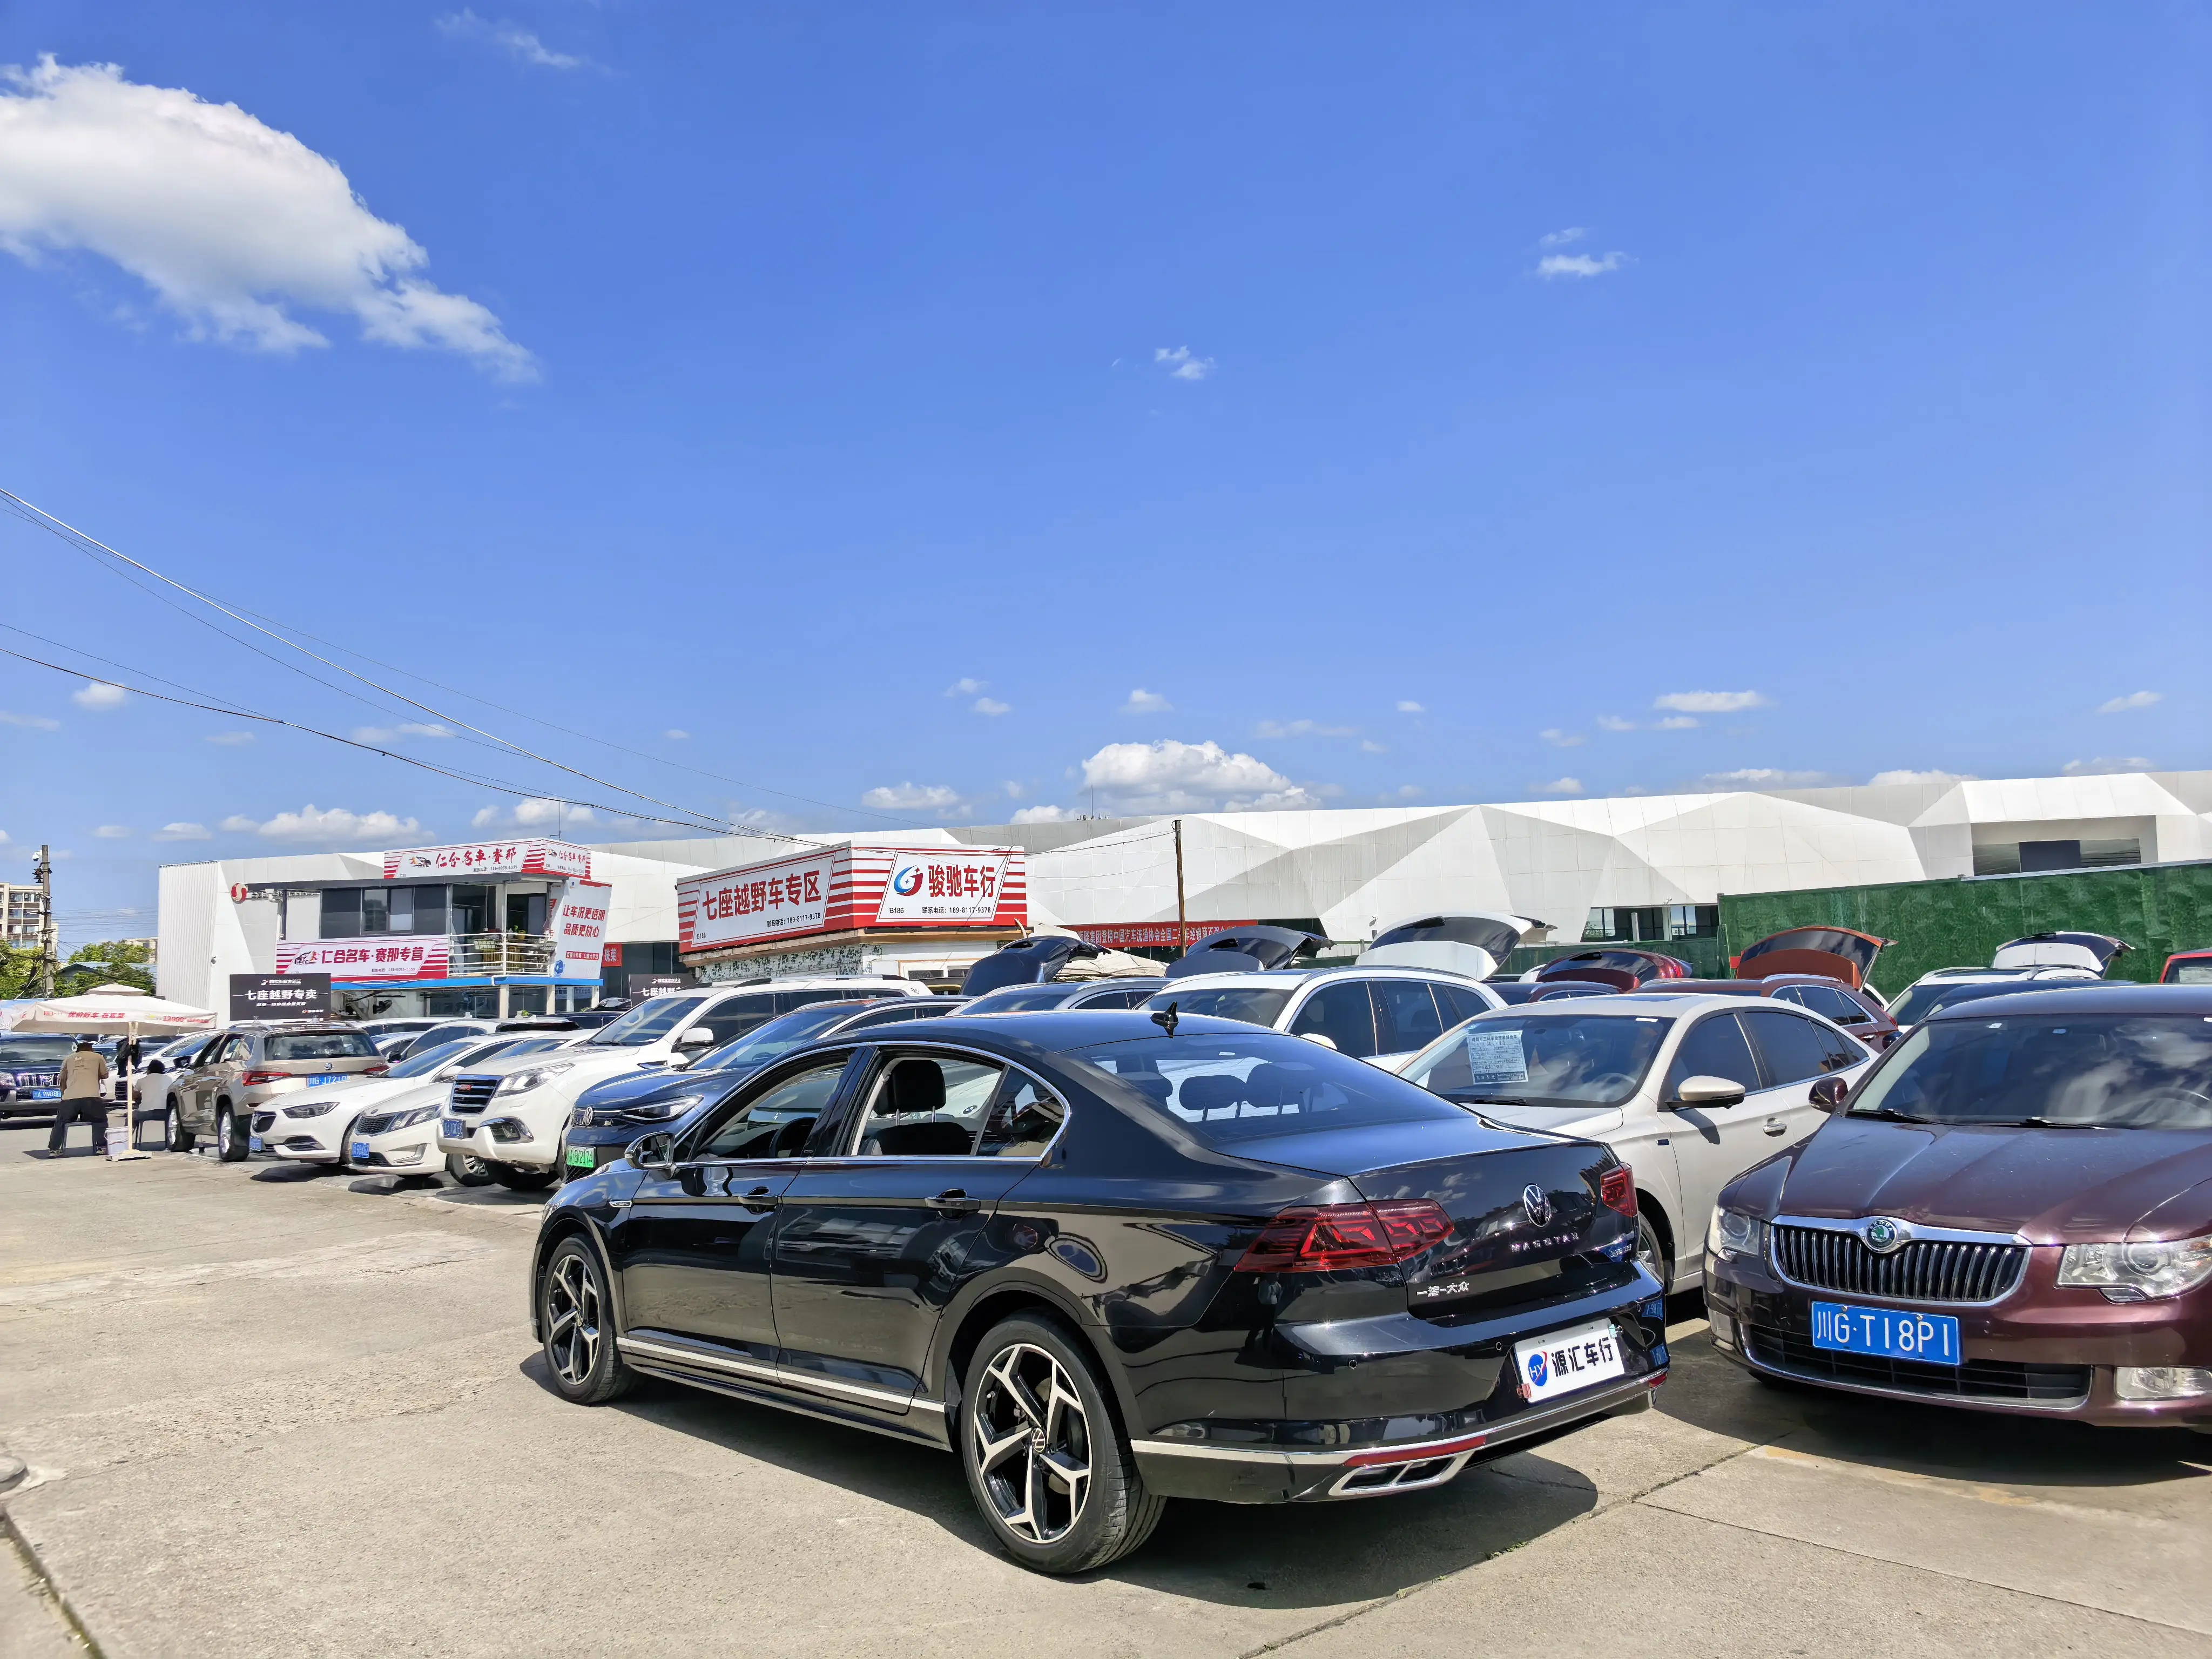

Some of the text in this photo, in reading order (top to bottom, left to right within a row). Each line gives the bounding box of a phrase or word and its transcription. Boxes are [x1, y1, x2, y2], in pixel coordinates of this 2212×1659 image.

[928, 864, 995, 898] 骏驰车行
[702, 870, 821, 921] 七座越野车专区
[562, 904, 606, 922] 让车况更透明
[563, 923, 599, 938] 品质更放心
[321, 946, 424, 964] 仁合名车·赛那专营
[245, 989, 318, 1000] 七座越野专卖
[1817, 1311, 1949, 1356] 川G·T18P1
[1551, 1337, 1613, 1377] 源汇车行
